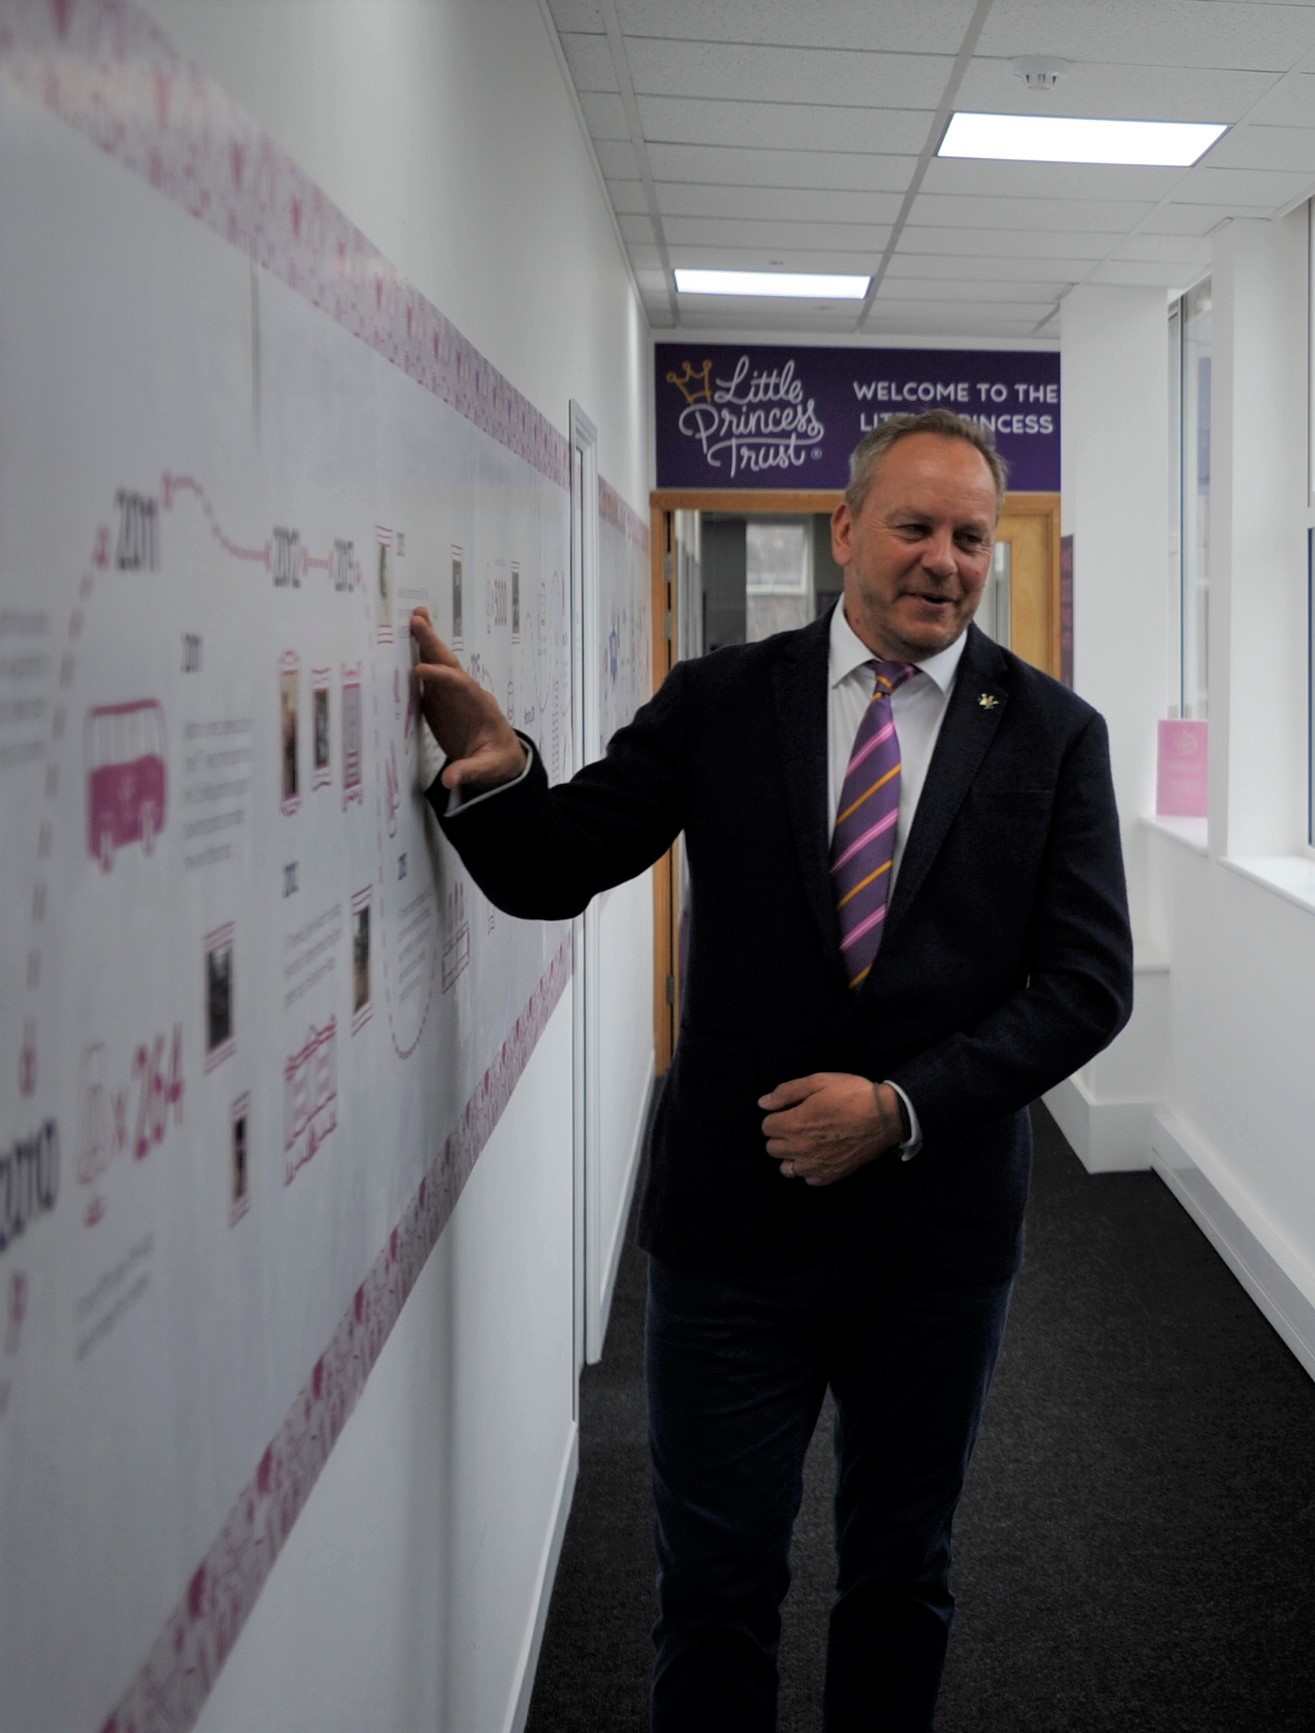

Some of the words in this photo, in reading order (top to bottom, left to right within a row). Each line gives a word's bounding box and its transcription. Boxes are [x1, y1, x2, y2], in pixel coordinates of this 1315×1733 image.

[714, 355, 803, 404] Little
[853, 381, 970, 402] WELCOME
[976, 383, 1008, 403] TO
[1014, 384, 1058, 404] THE
[679, 398, 824, 455] Princess
[706, 431, 807, 478] Trust
